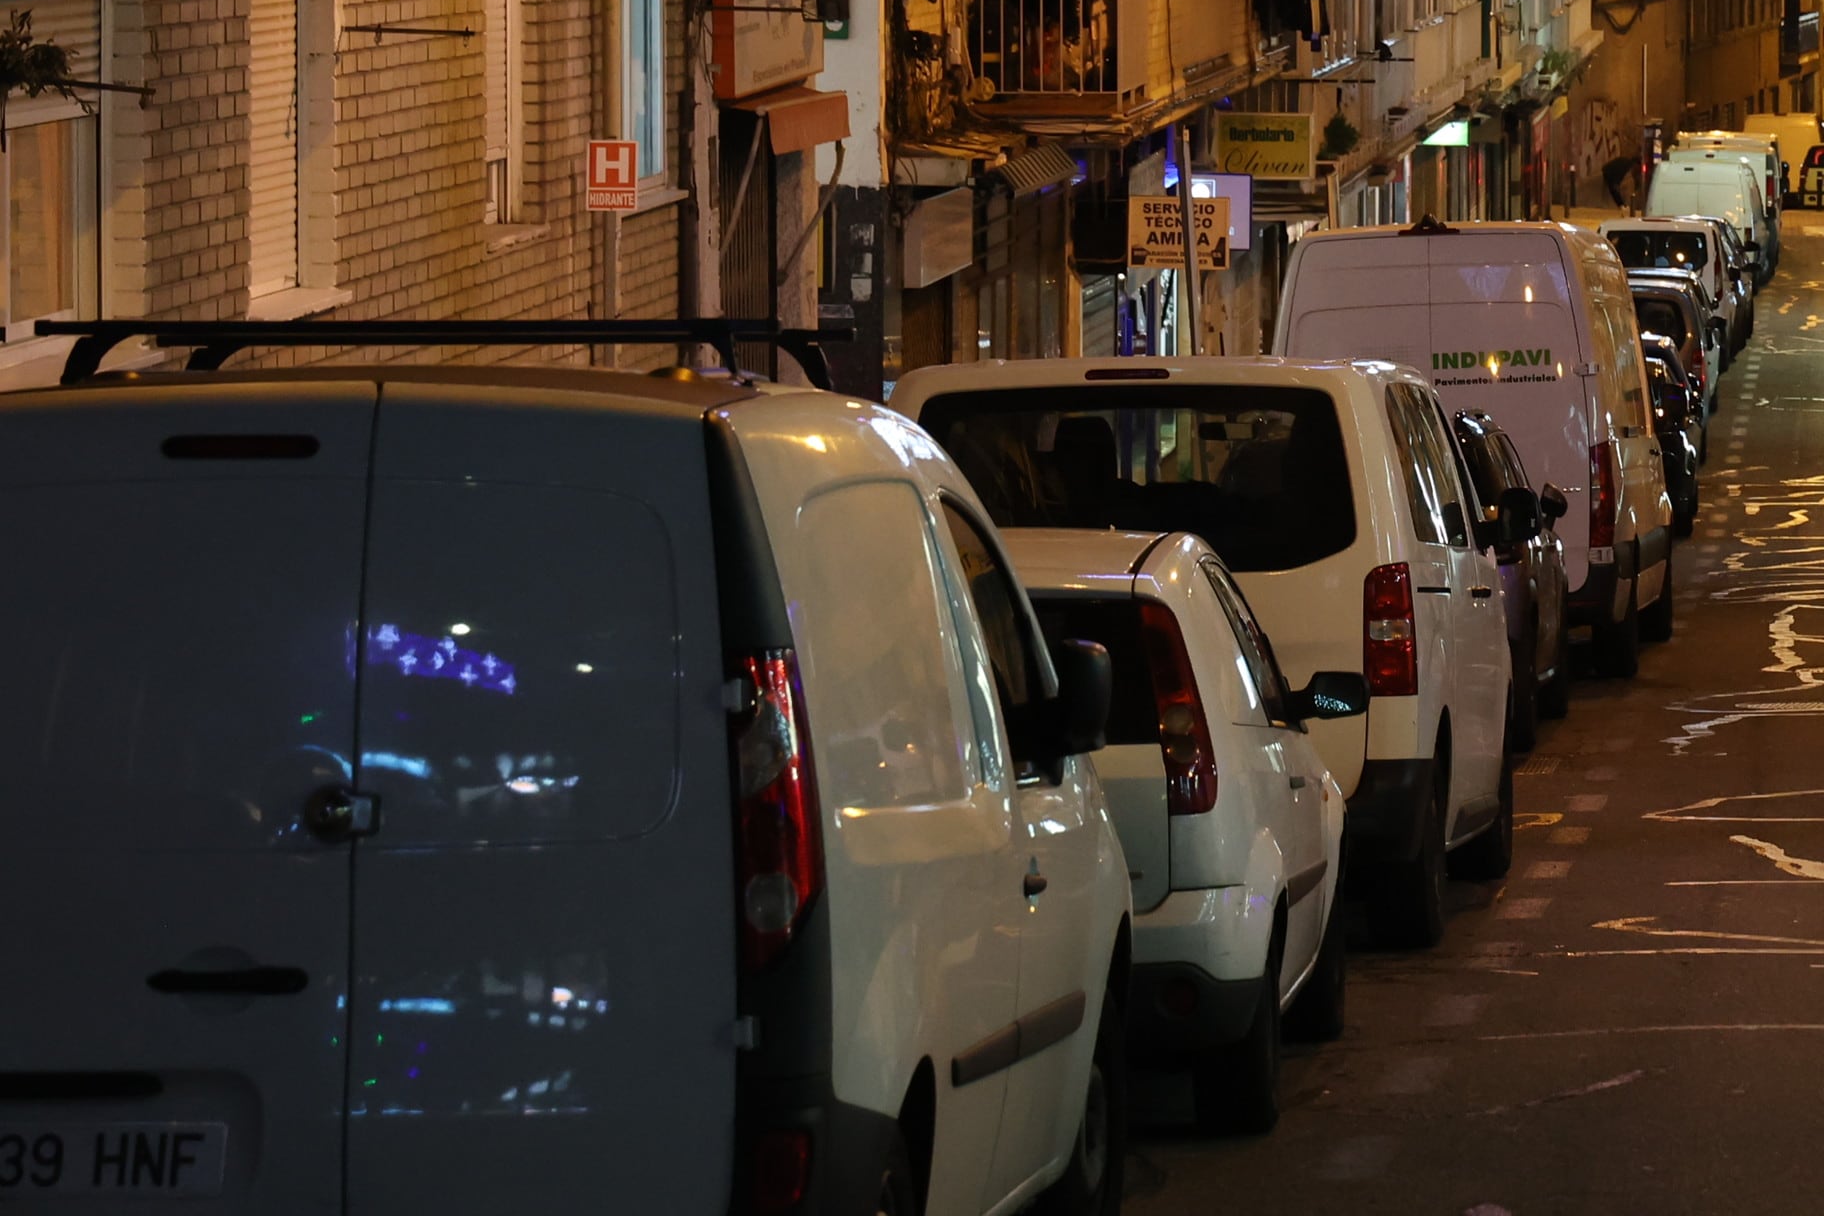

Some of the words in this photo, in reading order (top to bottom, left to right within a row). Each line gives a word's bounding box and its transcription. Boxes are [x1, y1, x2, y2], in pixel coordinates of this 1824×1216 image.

[596, 147, 630, 183] H
[590, 192, 635, 206] HIDRANTE
[1143, 203, 1215, 215] SERVCIO
[1145, 215, 1212, 229] TÉCNCO
[1147, 232, 1210, 246] AMIA
[91, 1133, 205, 1186] HNF
